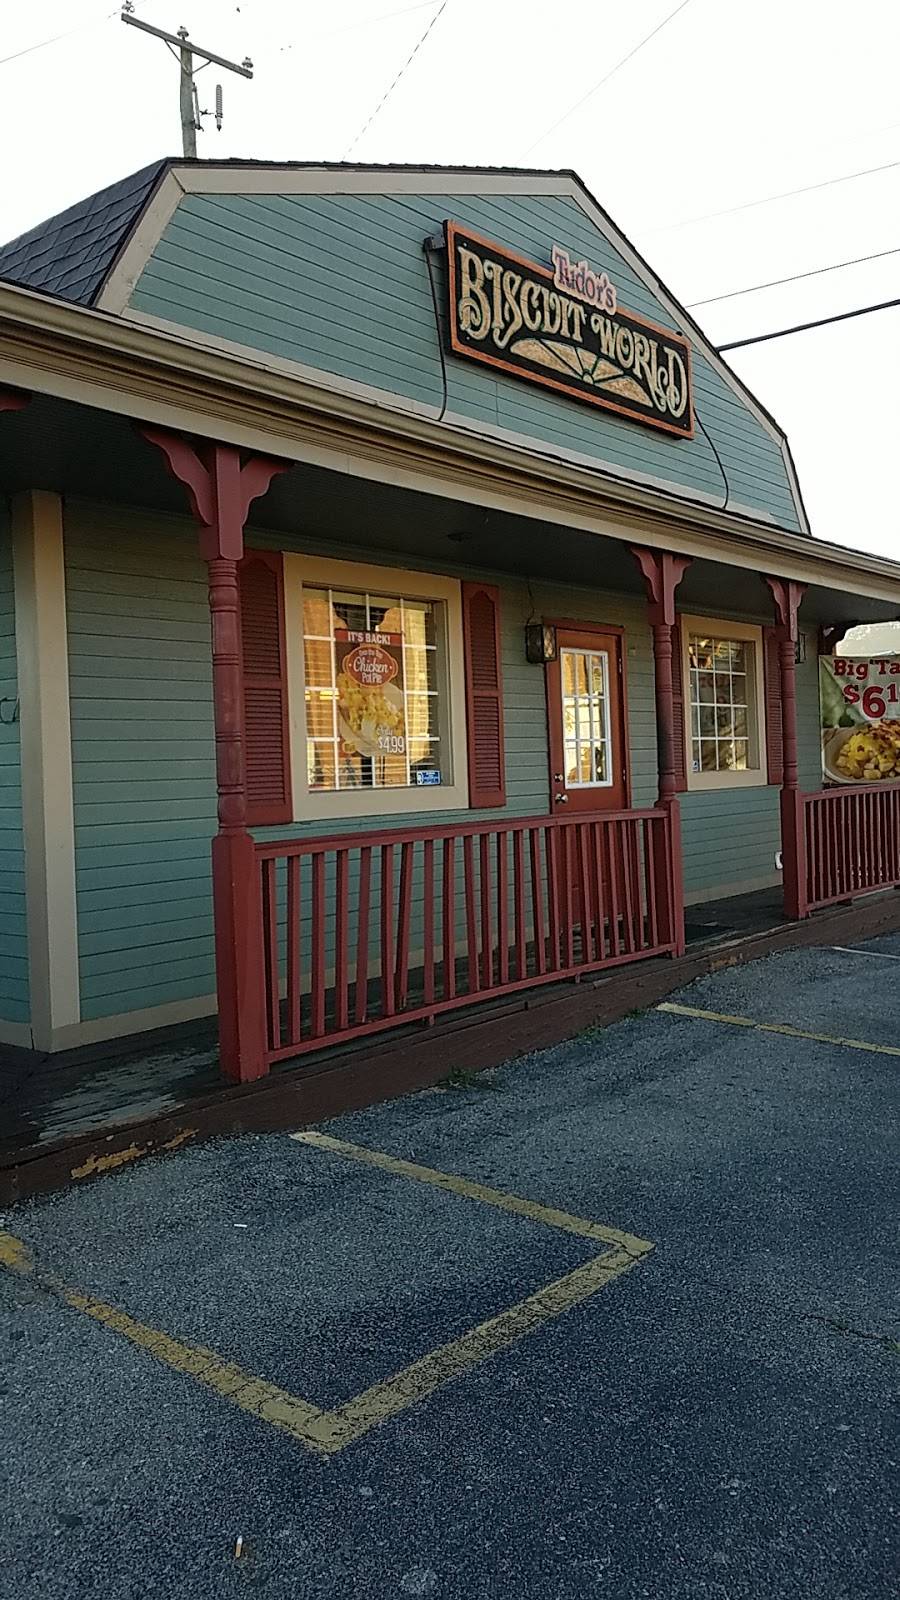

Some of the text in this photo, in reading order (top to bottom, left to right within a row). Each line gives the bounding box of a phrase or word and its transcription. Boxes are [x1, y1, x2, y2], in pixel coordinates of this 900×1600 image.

[553, 250, 616, 310] Tudor's
[457, 246, 687, 418] BISCUIT WORLD
[347, 631, 391, 645] IT'S BACK!
[353, 656, 389, 673] Chicken
[833, 659, 869, 681] Big
[843, 683, 900, 718] $61
[377, 735, 405, 754] $4.99
